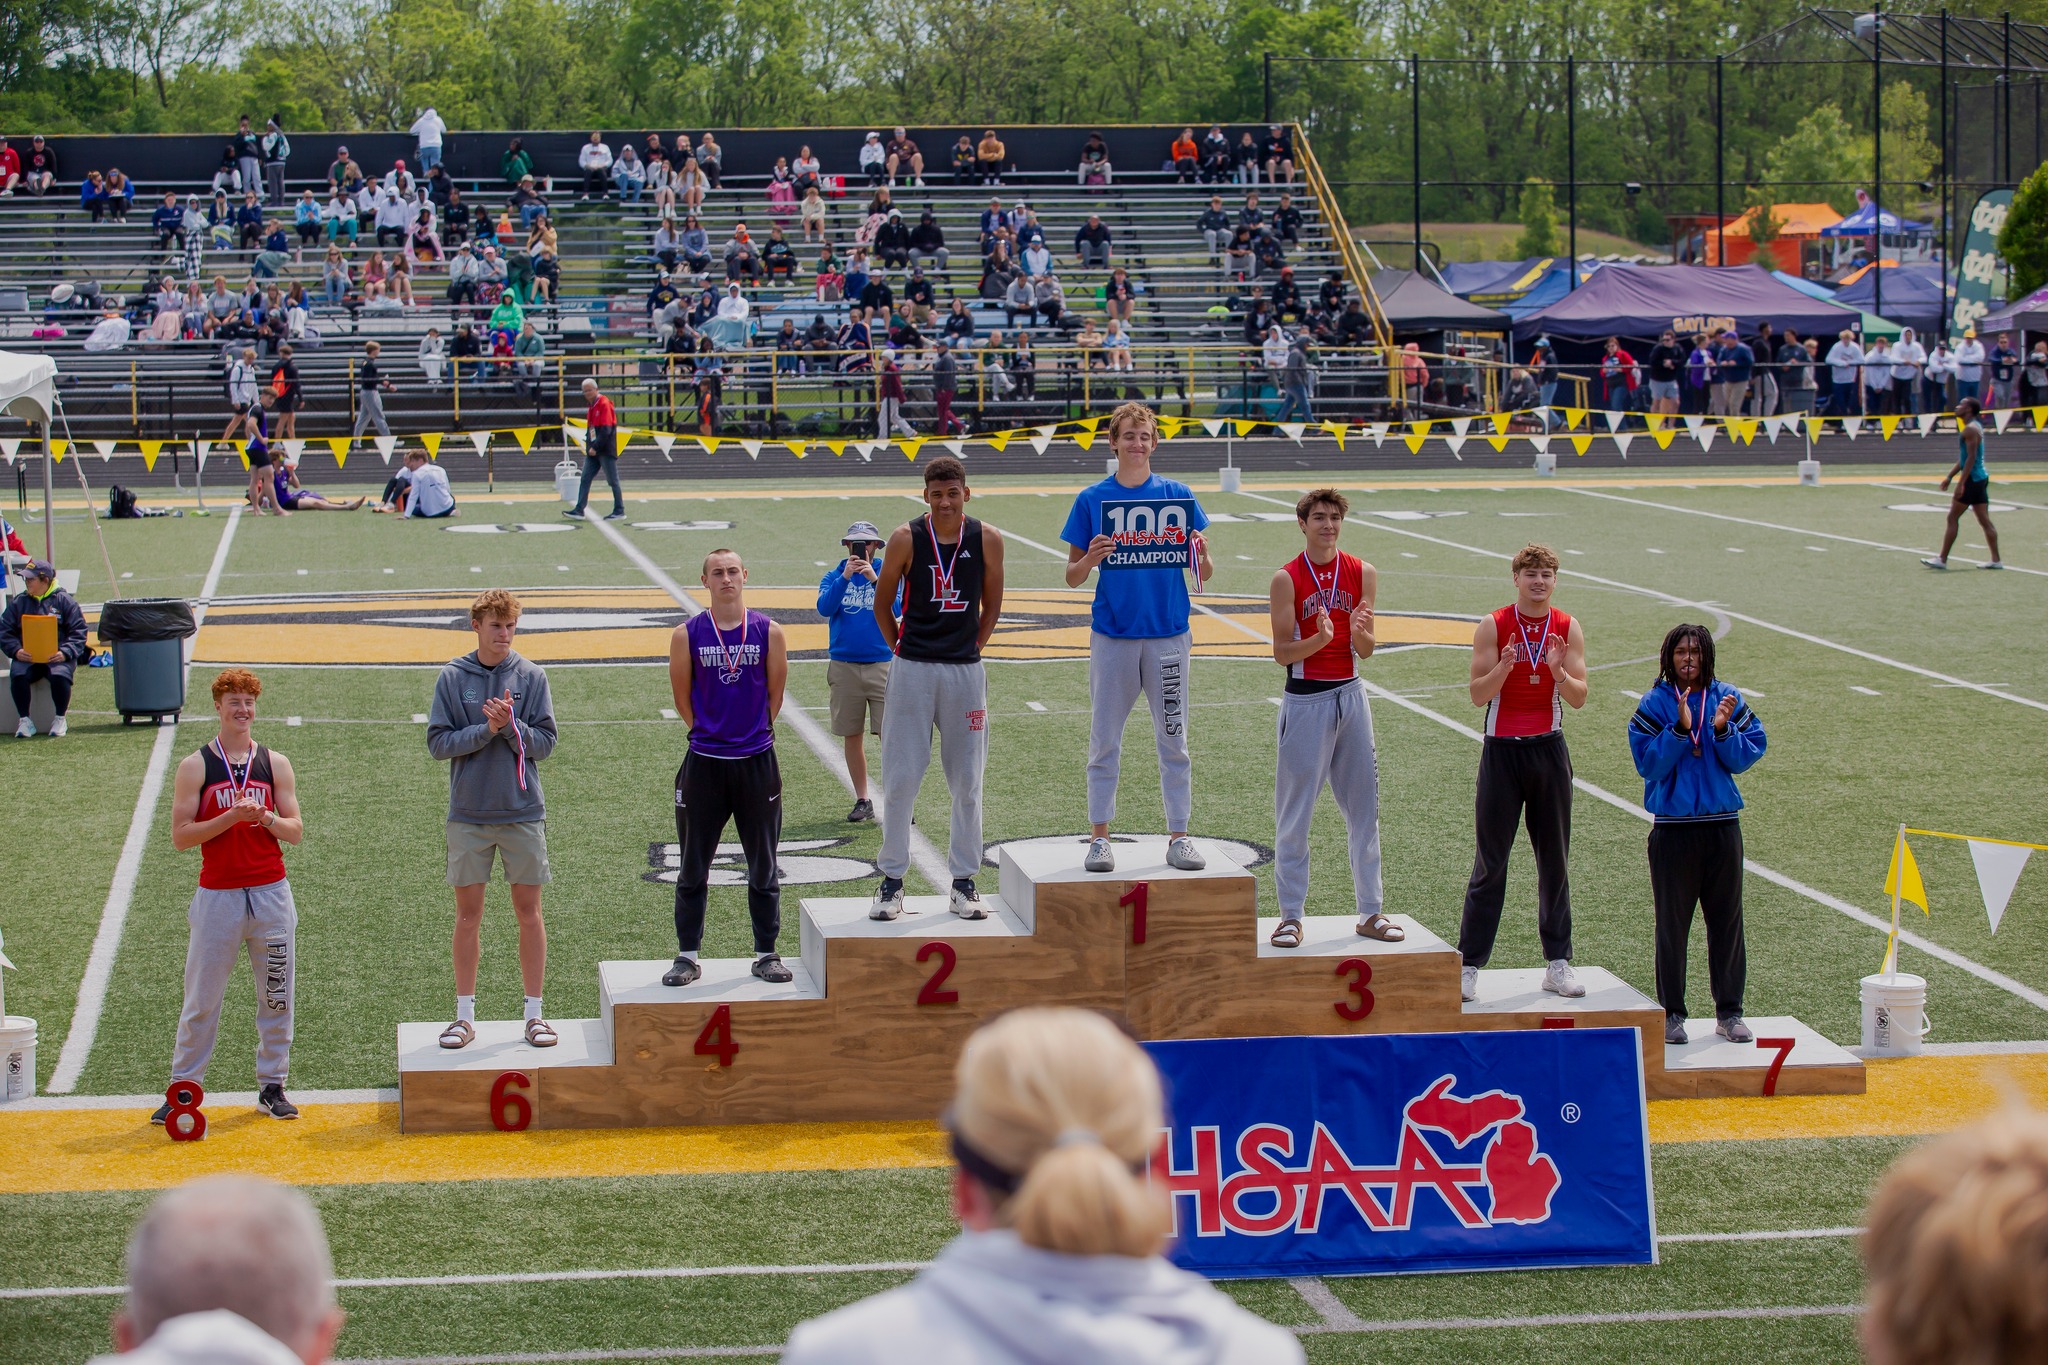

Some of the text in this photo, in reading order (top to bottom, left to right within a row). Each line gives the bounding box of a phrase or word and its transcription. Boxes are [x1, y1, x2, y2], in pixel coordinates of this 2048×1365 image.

[1107, 505, 1187, 536] 100
[1111, 530, 1176, 546] MHSAA
[1107, 551, 1187, 565] CHAMPION
[1120, 881, 1148, 943] 1
[916, 941, 959, 1005] 2
[1334, 958, 1375, 1021] 3
[694, 1004, 739, 1066] 4
[1756, 1037, 1795, 1096] 7
[165, 1080, 206, 1141] 8
[490, 1071, 531, 1132] 6
[1146, 1119, 1493, 1237] HSAA
